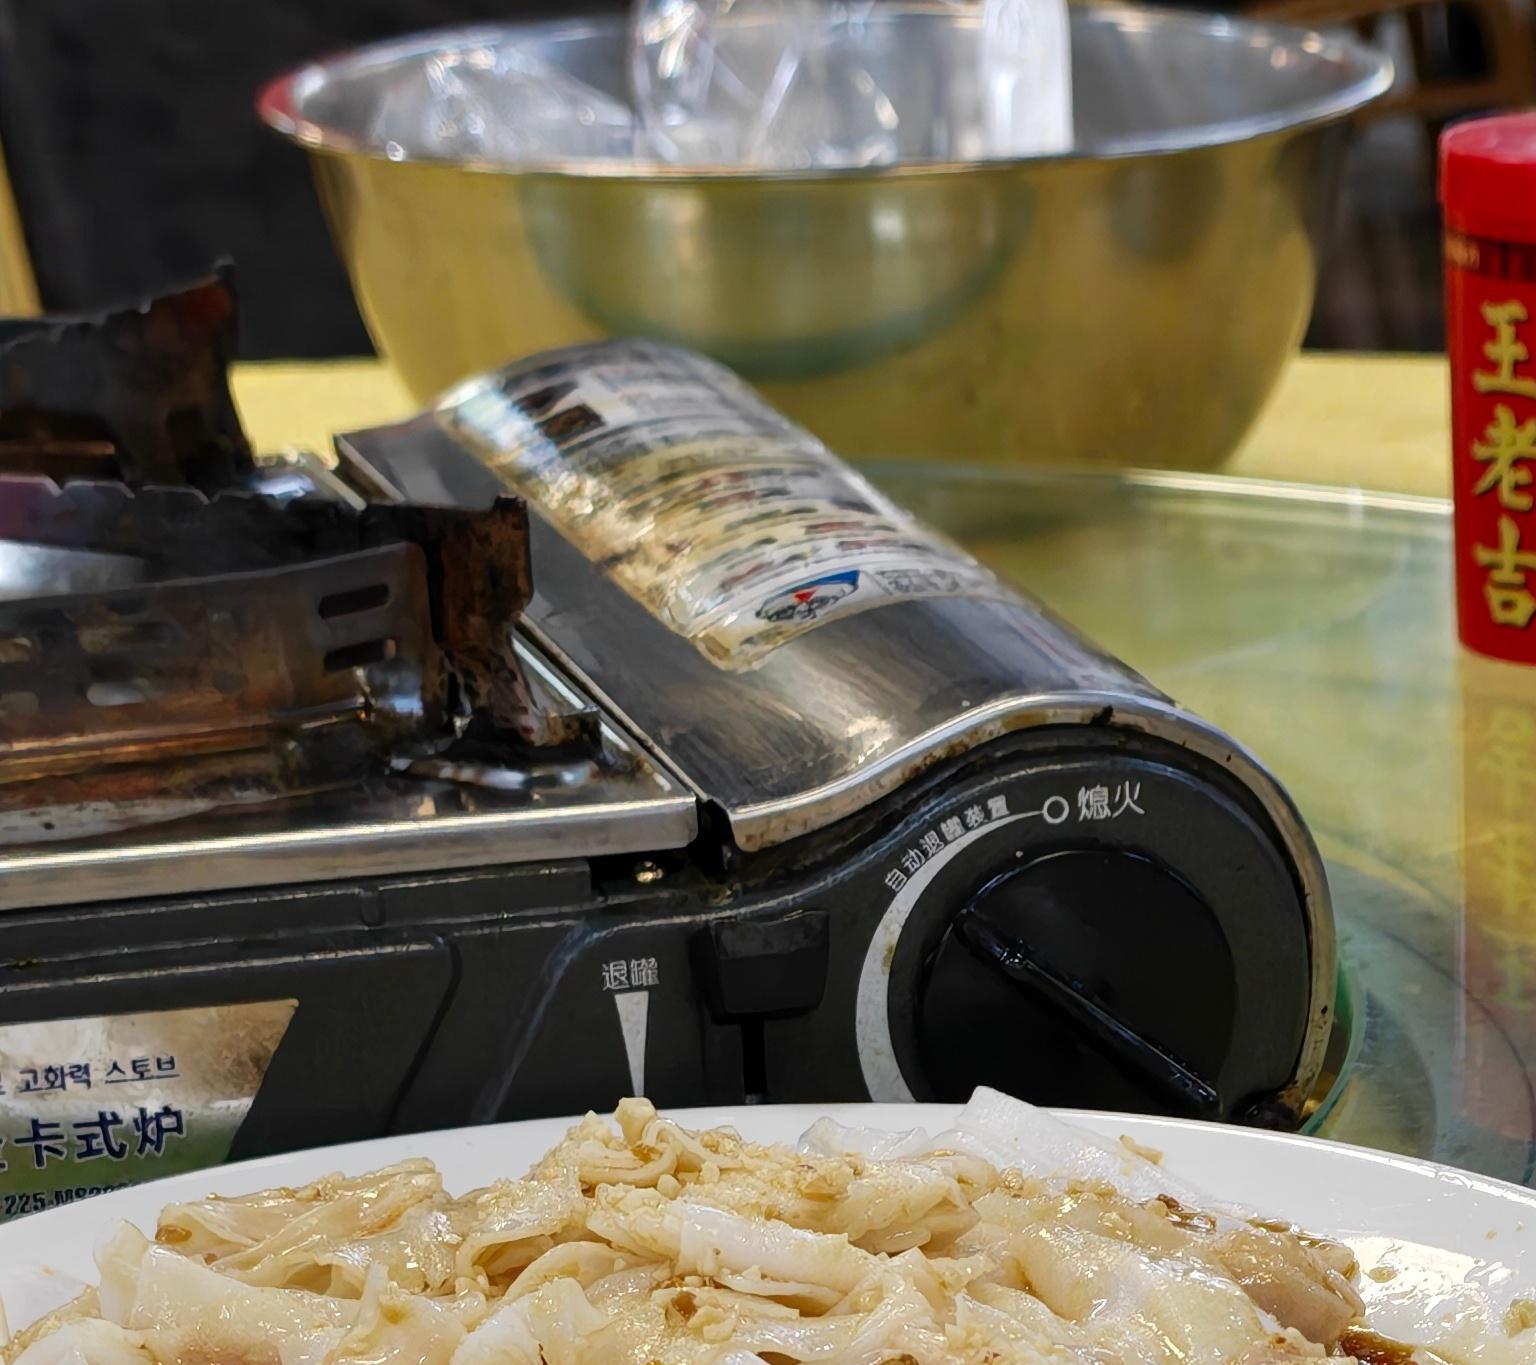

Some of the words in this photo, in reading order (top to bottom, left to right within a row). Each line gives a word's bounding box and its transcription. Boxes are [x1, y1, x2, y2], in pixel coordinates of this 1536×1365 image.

[1078, 780, 1145, 822] 熄火
[601, 957, 660, 991] 退罐
[18, 1062, 92, 1092] 고화력
[105, 1055, 180, 1084] 스토브
[0, 1104, 186, 1171] 卡式炉
